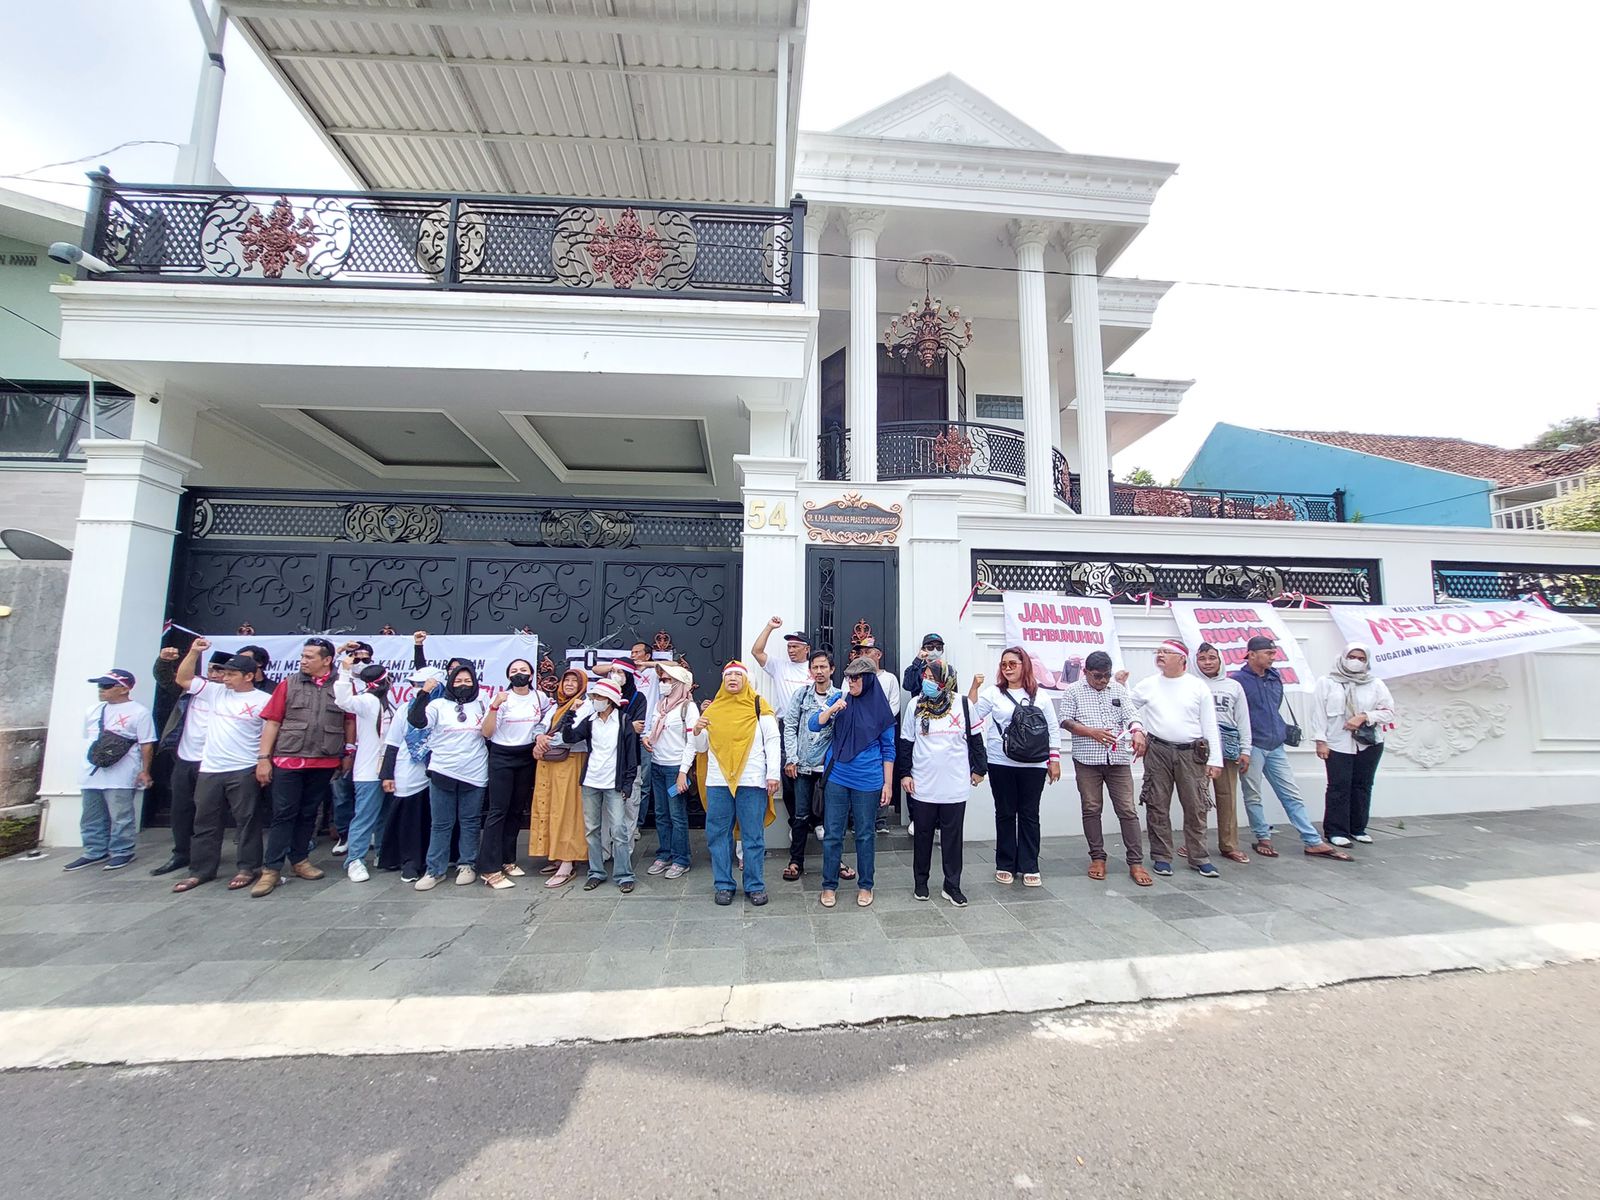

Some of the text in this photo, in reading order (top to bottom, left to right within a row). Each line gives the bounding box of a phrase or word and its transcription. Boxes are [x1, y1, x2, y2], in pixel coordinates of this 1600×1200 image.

[747, 499, 787, 531] 54
[1018, 602, 1102, 627] JANJIMU
[1022, 628, 1105, 644] MEMBUNUHKU
[1365, 610, 1550, 646] MENOLAK
[1375, 648, 1412, 663] GUGATAN
